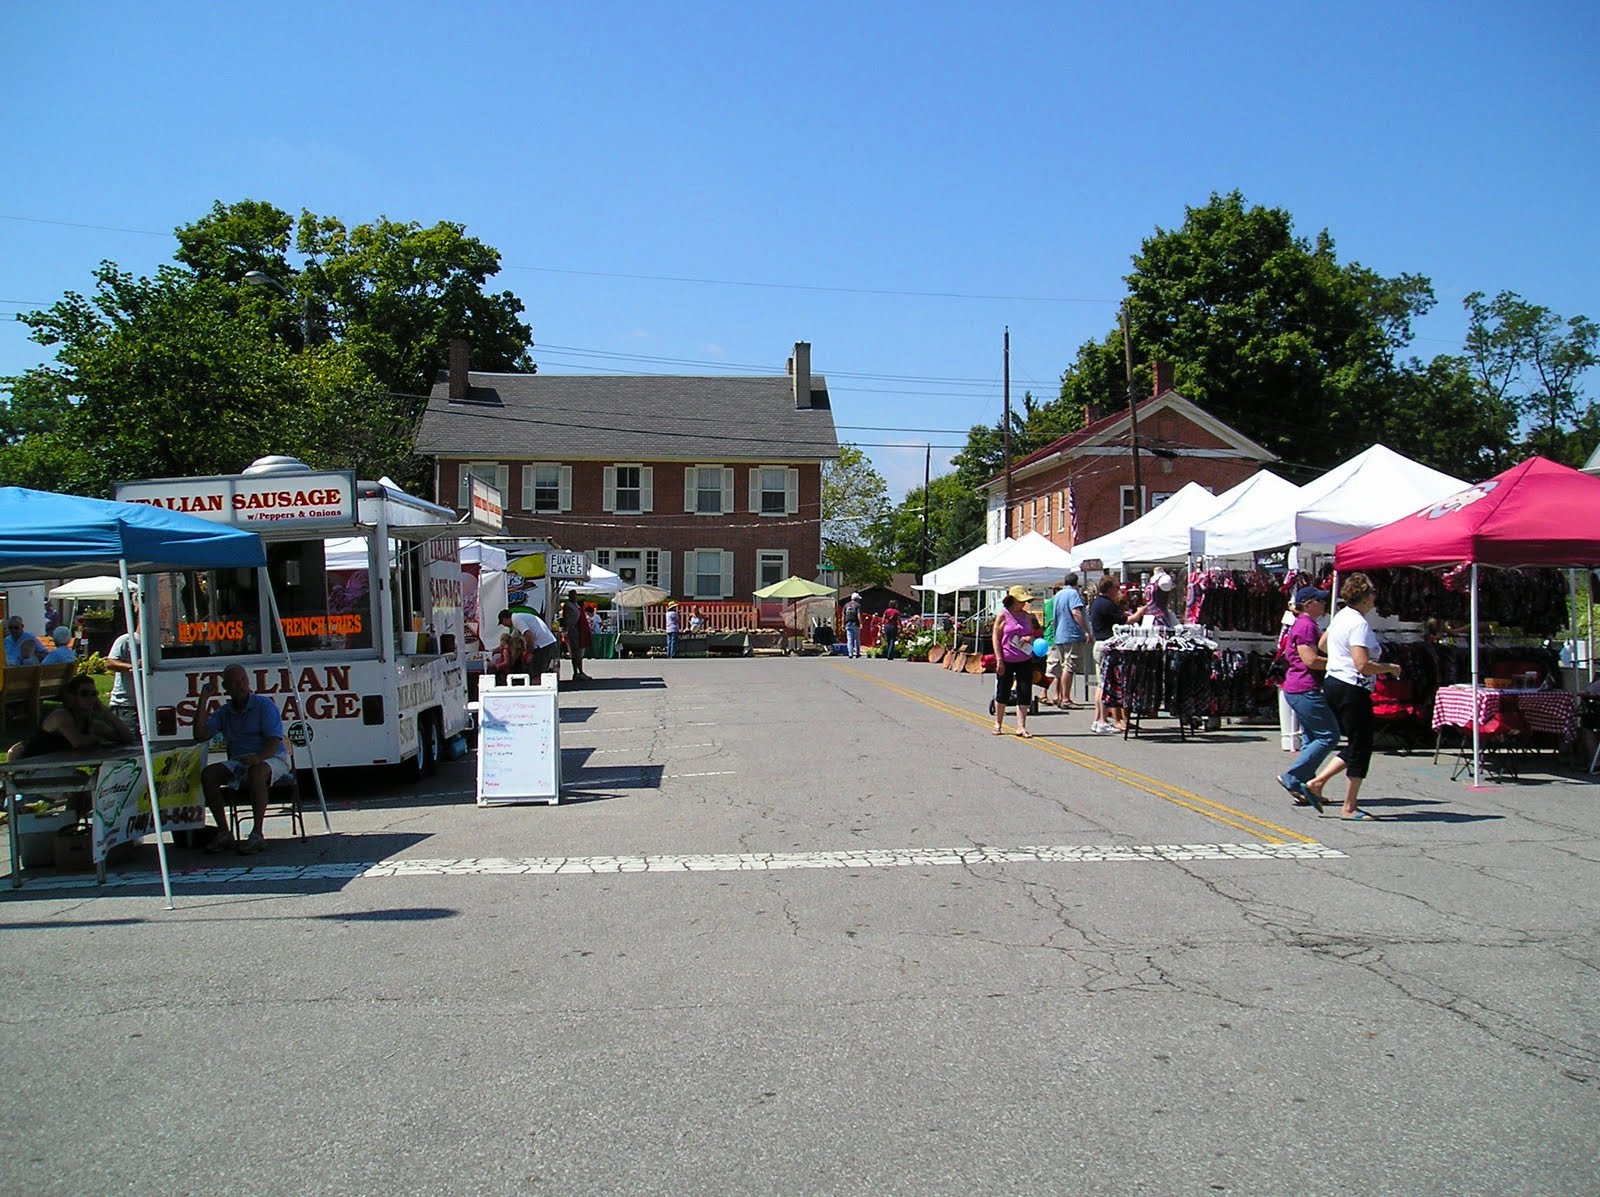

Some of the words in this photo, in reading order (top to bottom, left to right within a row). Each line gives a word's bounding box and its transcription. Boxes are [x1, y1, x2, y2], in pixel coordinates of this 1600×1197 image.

[126, 495, 223, 512] ALIAN
[231, 489, 342, 510] SAUSAGE
[247, 512, 295, 522] w/Peppers
[298, 510, 306, 518] &
[309, 508, 342, 517] Onions
[550, 565, 582, 575] CAKES
[551, 554, 581, 566] FUNNEL
[178, 621, 205, 643] HOT
[207, 620, 244, 641] DOGS
[280, 616, 325, 637] FRENCH
[328, 614, 362, 635] FRIES
[185, 665, 351, 698] ITLIAN
[176, 693, 361, 727] SAGE
